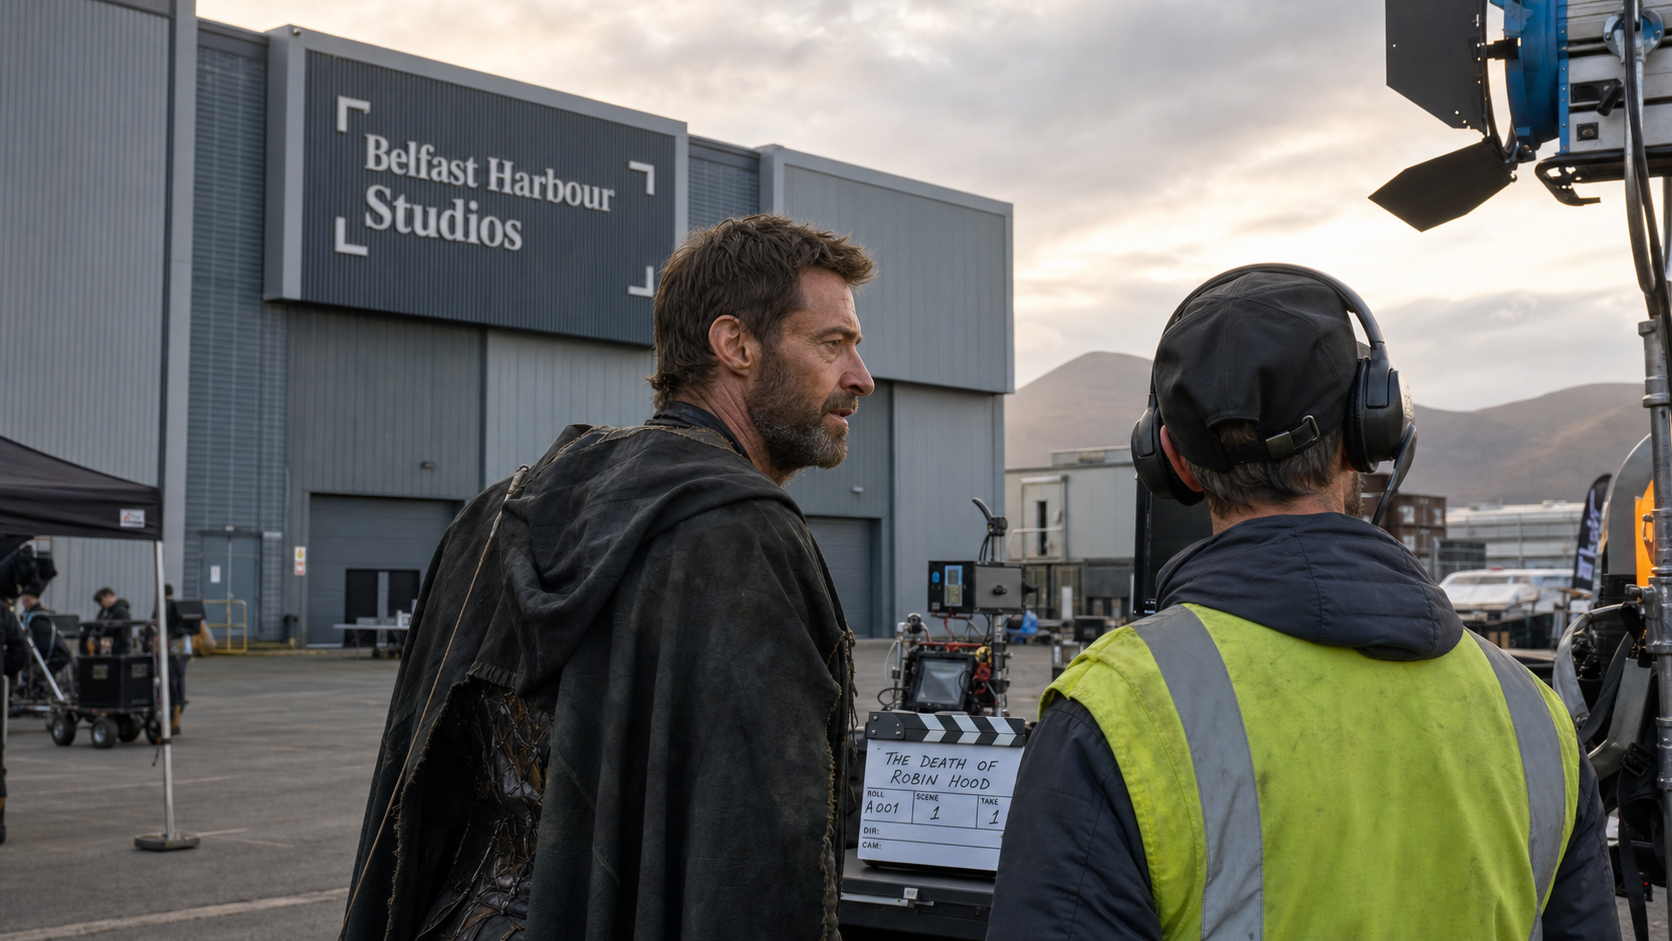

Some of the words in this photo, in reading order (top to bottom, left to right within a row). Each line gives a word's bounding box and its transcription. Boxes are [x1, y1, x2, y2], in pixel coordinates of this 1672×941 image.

[364, 134, 479, 189] Belfast
[487, 157, 615, 213] Harbour
[364, 185, 523, 252] Studios
[885, 752, 911, 765] THE
[920, 755, 967, 769] DEATH
[977, 760, 998, 771] OF
[890, 770, 938, 785] ROBIN
[948, 775, 990, 790] HOOD
[867, 790, 885, 798] ROLL
[865, 800, 899, 814] A001
[930, 806, 940, 820] 1
[989, 810, 999, 824] 1
[864, 827, 879, 835] DIR:
[862, 842, 882, 850] CAM:
